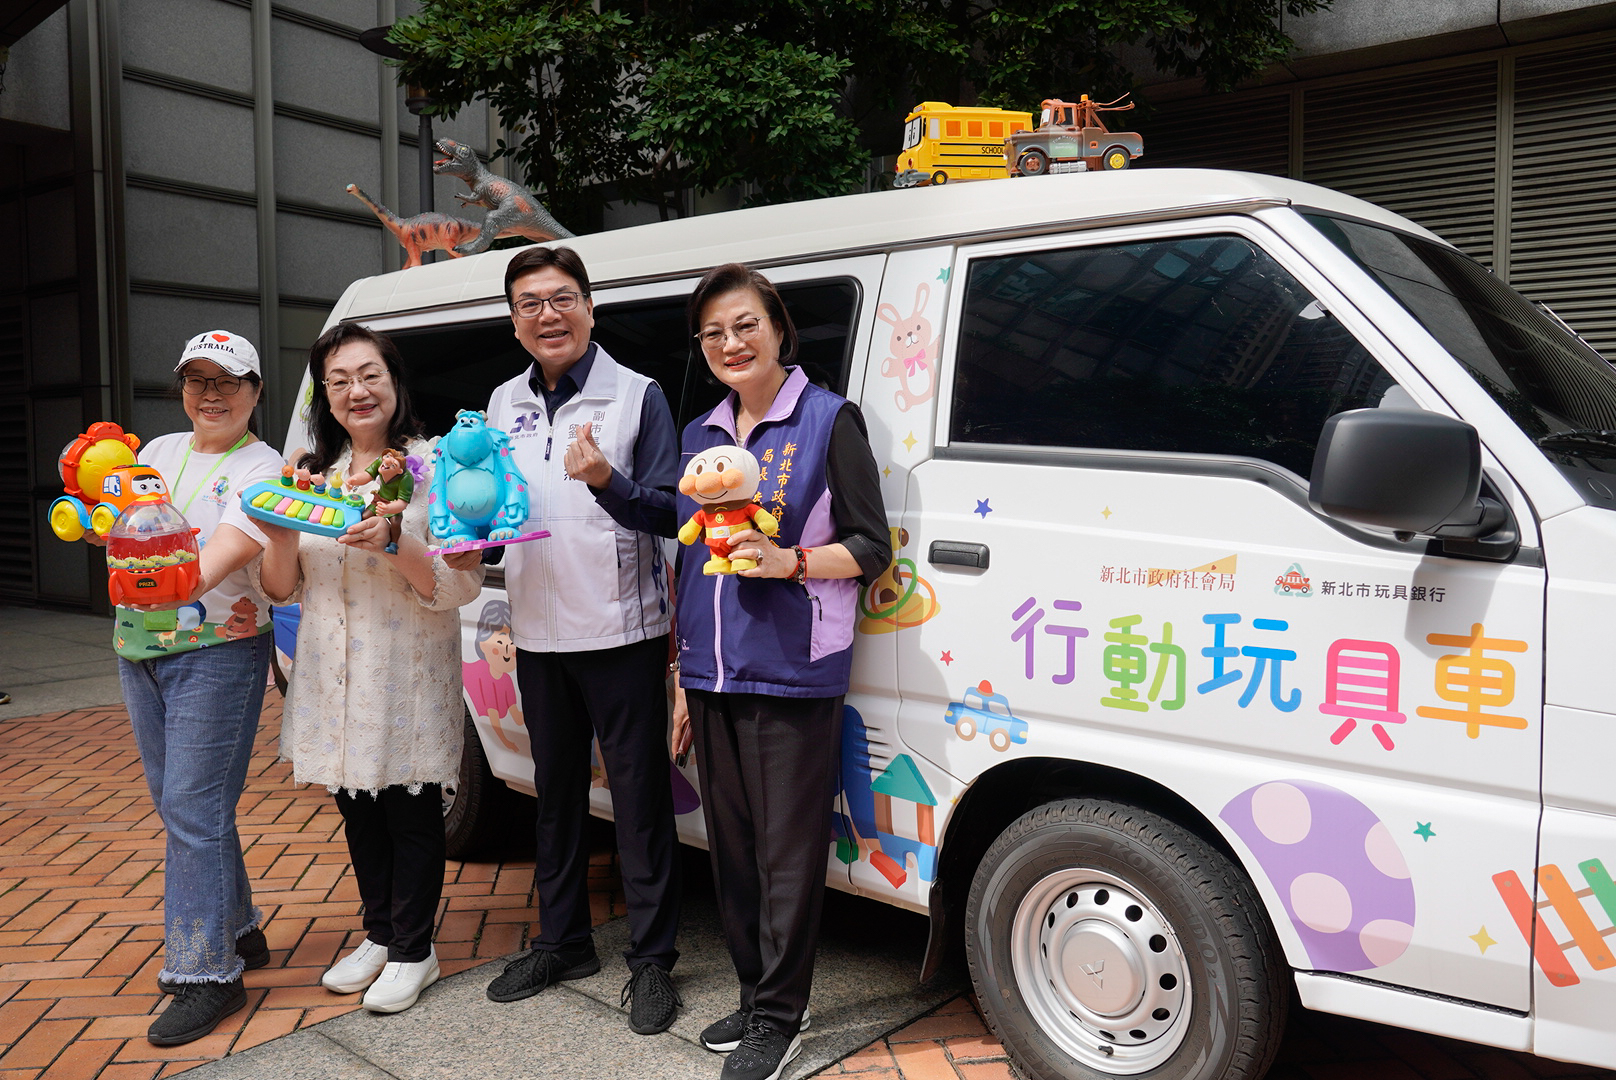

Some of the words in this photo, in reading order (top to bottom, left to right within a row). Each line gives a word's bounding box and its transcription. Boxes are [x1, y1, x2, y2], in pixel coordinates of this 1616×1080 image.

[1100, 565, 1235, 592] 新北市政府社會局
[1321, 580, 1446, 603] 新北市玩具銀行
[1011, 596, 1529, 752] 行動玩具車
[1108, 841, 1218, 964] KOMENDO
